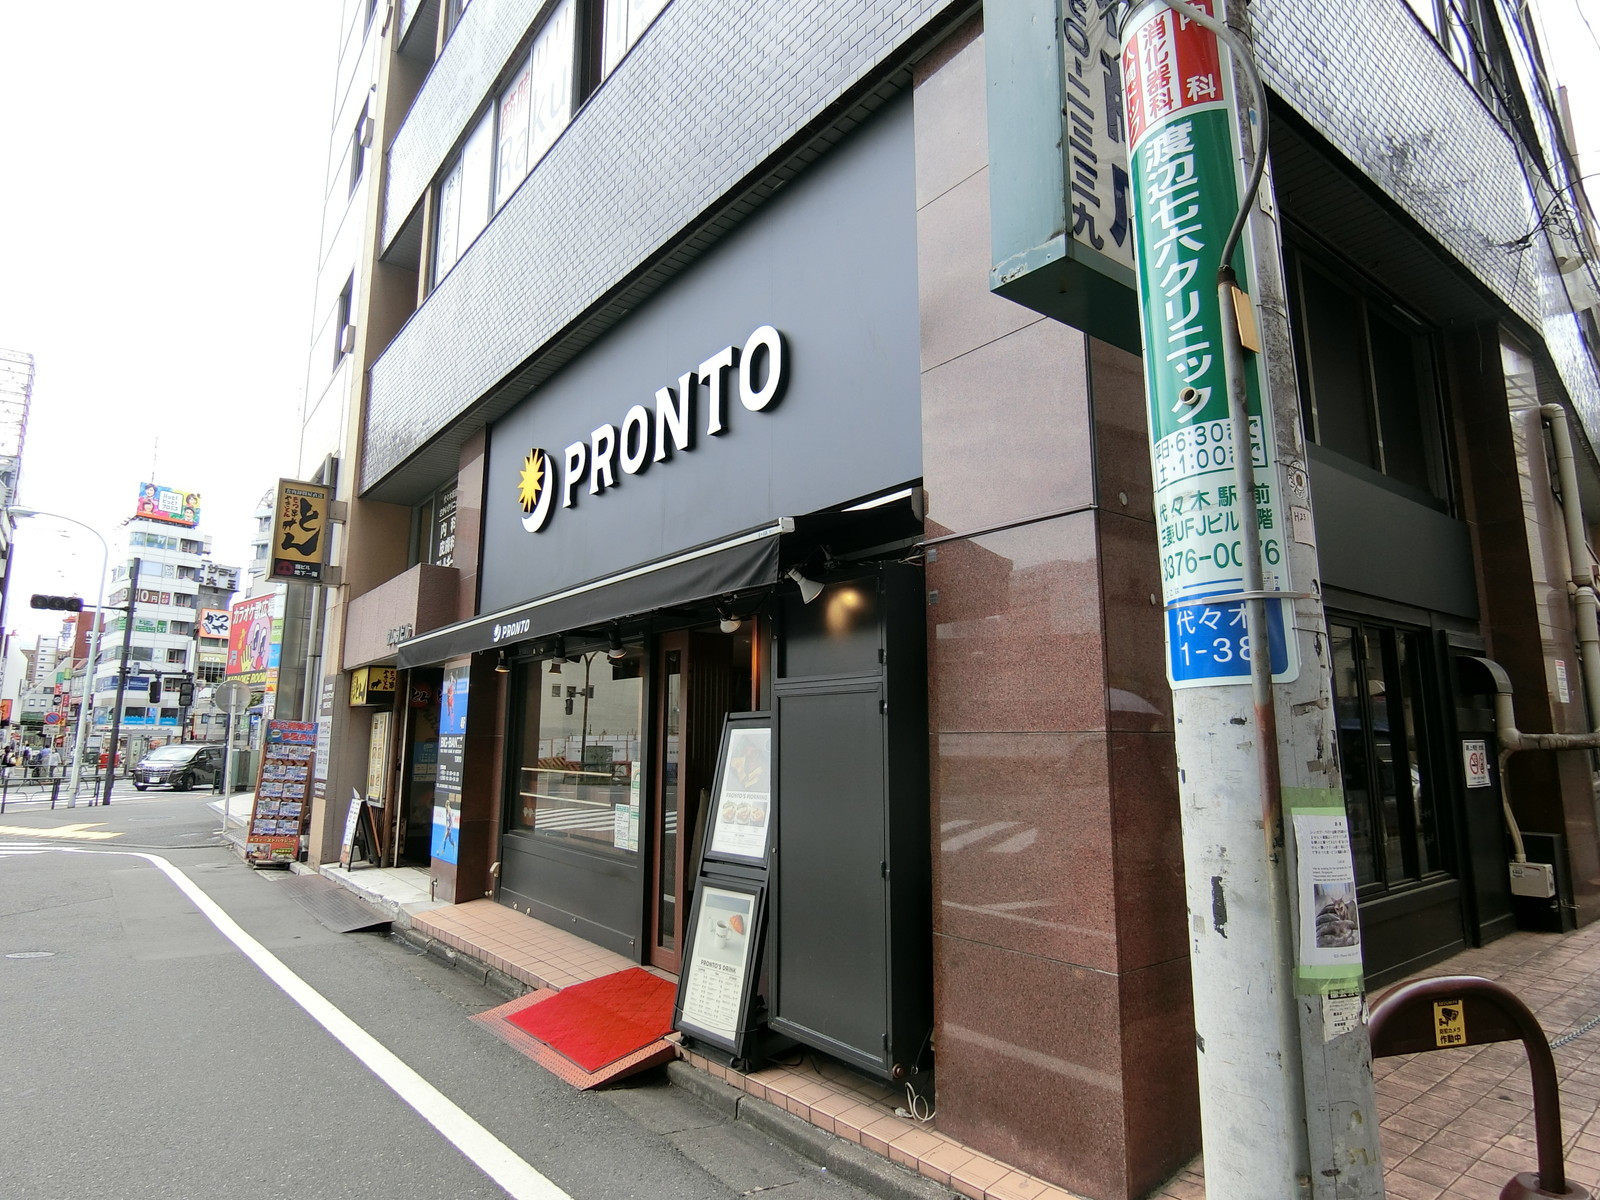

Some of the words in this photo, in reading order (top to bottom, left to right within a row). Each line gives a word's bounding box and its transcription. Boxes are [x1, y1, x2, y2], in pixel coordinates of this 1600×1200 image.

[1143, 15, 1173, 119] 消化器科
[562, 324, 784, 509] PRONTO
[281, 497, 321, 556] とん
[1161, 507, 1274, 548] 三菱UFJビル階
[1163, 538, 1281, 582] 3376-006
[501, 618, 530, 640] PRONTO
[700, 959, 722, 970] PRONTO'S
[722, 964, 737, 974] DRINK
[1440, 1034, 1462, 1045] 作動中
